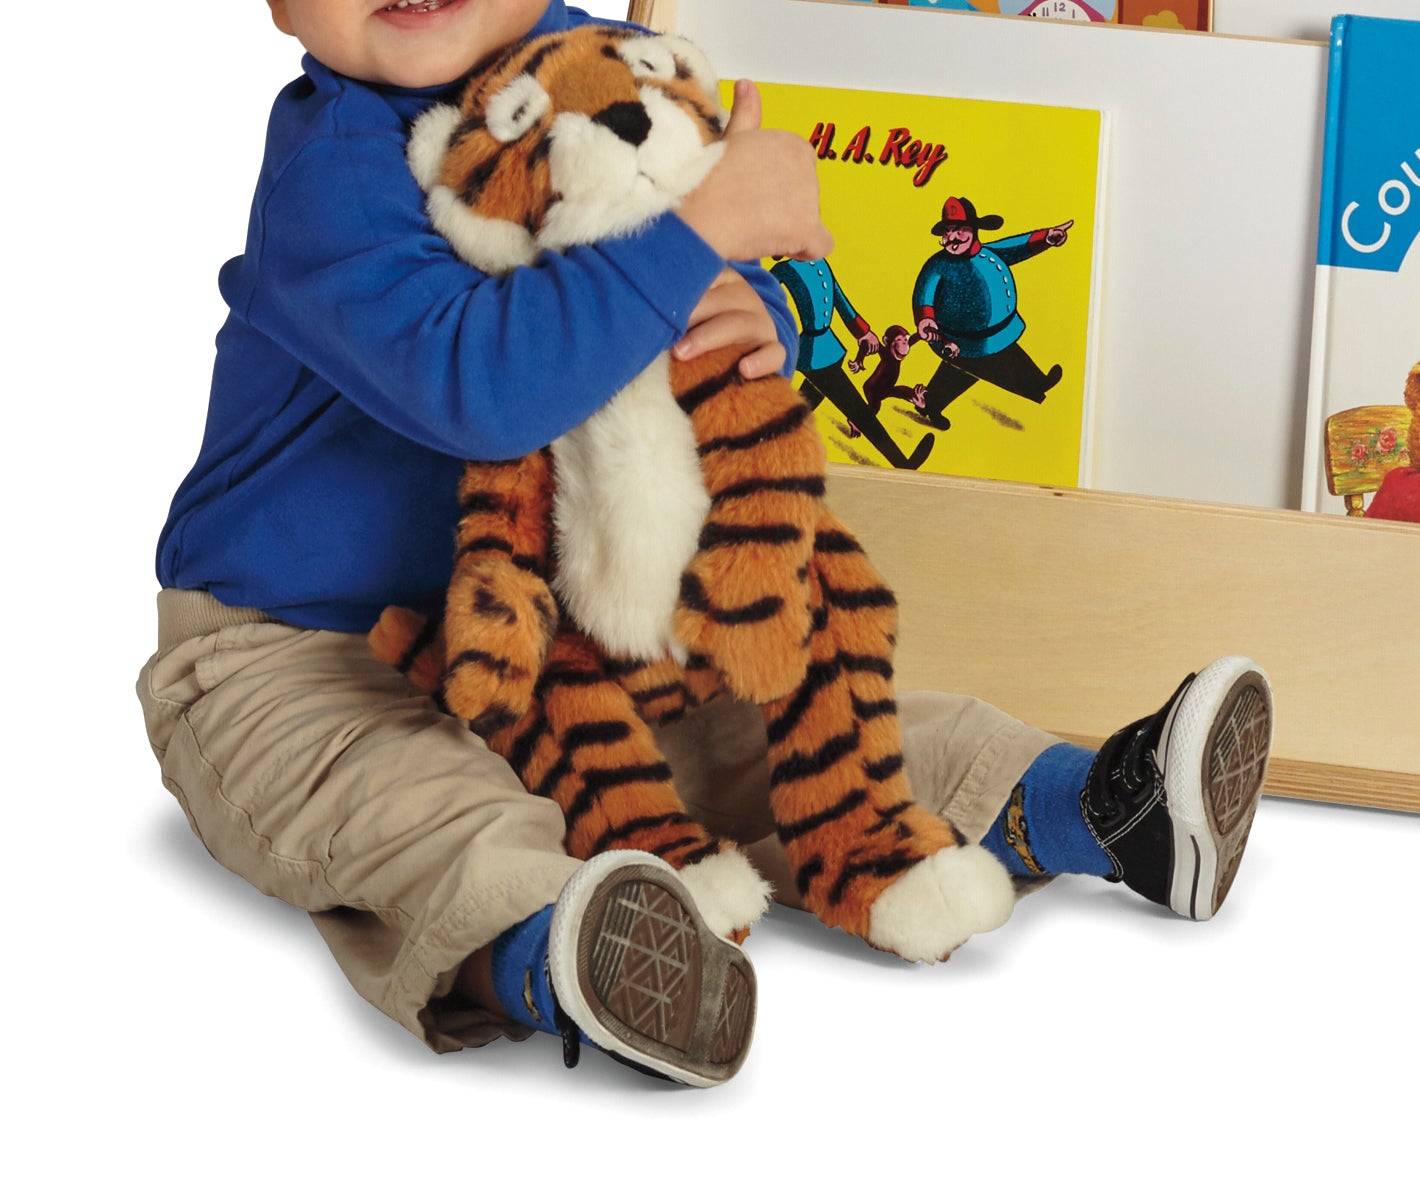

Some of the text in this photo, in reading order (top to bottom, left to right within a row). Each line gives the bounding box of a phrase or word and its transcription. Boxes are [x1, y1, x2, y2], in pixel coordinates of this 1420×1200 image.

[1054, 2, 1066, 12] 12
[809, 122, 948, 188] H. A. Rey
